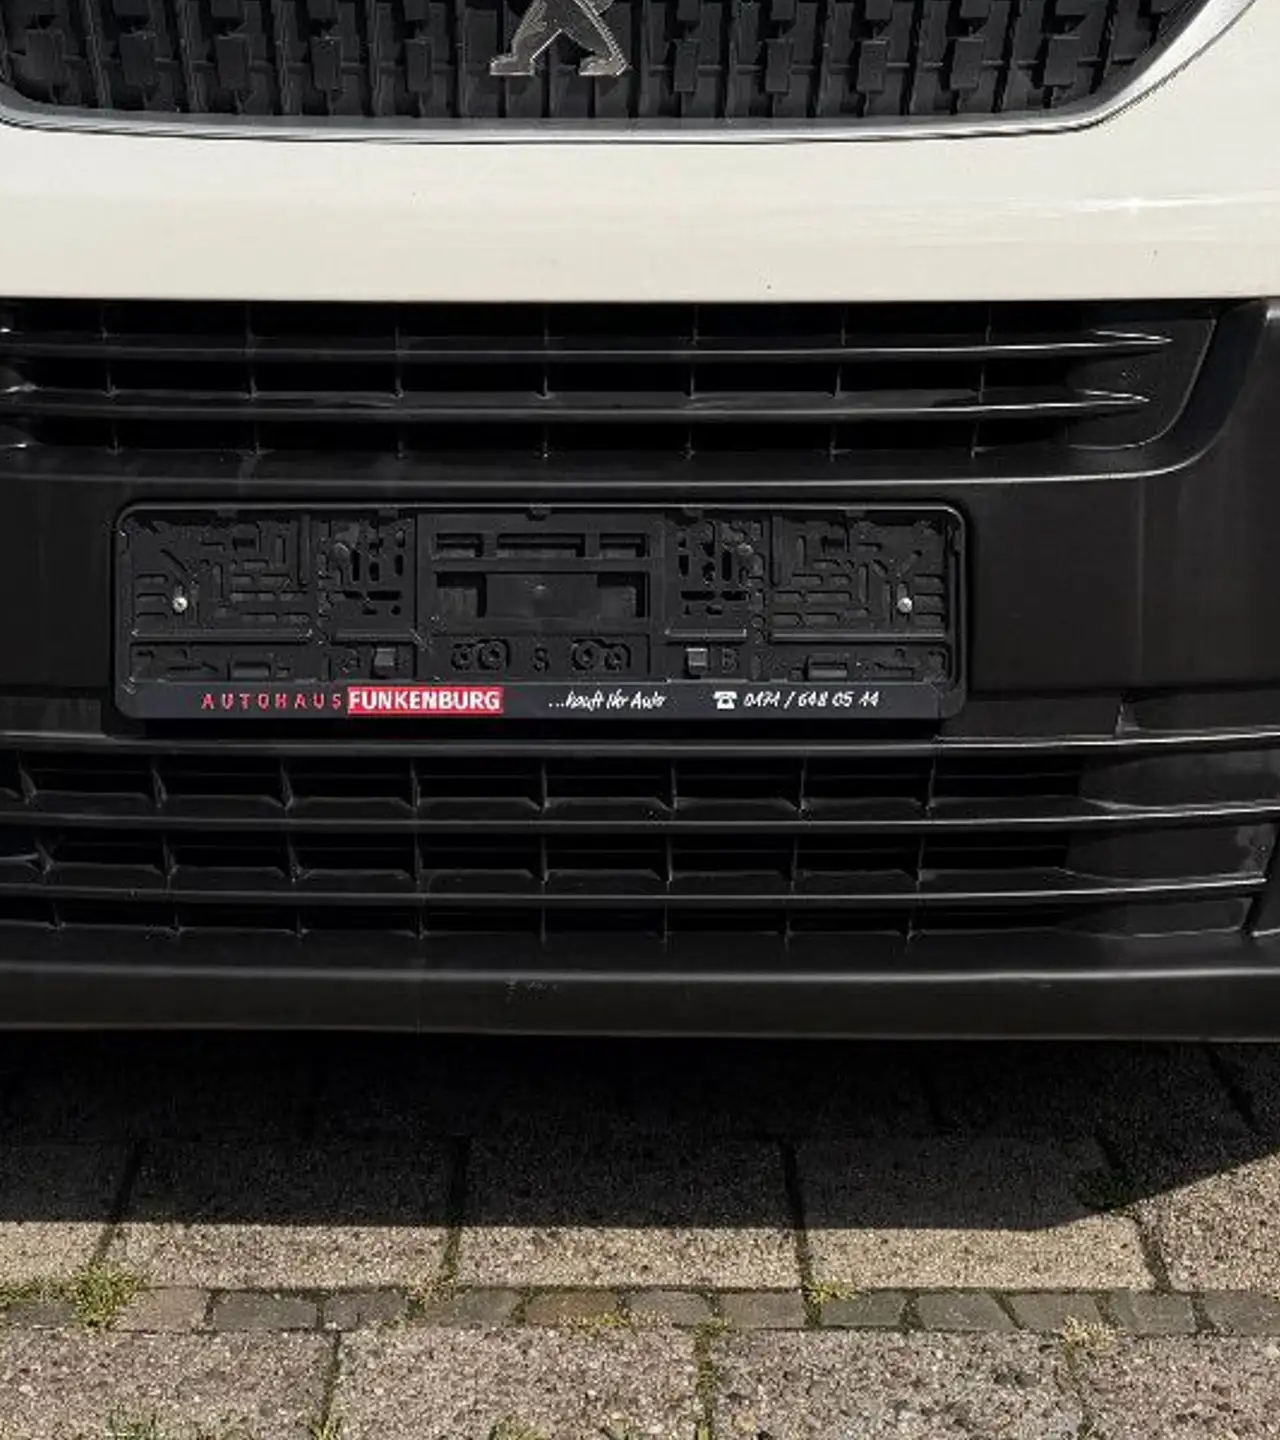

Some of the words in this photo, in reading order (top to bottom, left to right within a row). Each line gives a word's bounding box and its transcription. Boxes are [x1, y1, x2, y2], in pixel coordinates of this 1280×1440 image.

[200, 692, 342, 710] AUTOHAUS
[348, 690, 500, 711] FUNKENBURG
[630, 690, 667, 710] Auto
[831, 691, 854, 708] 05
